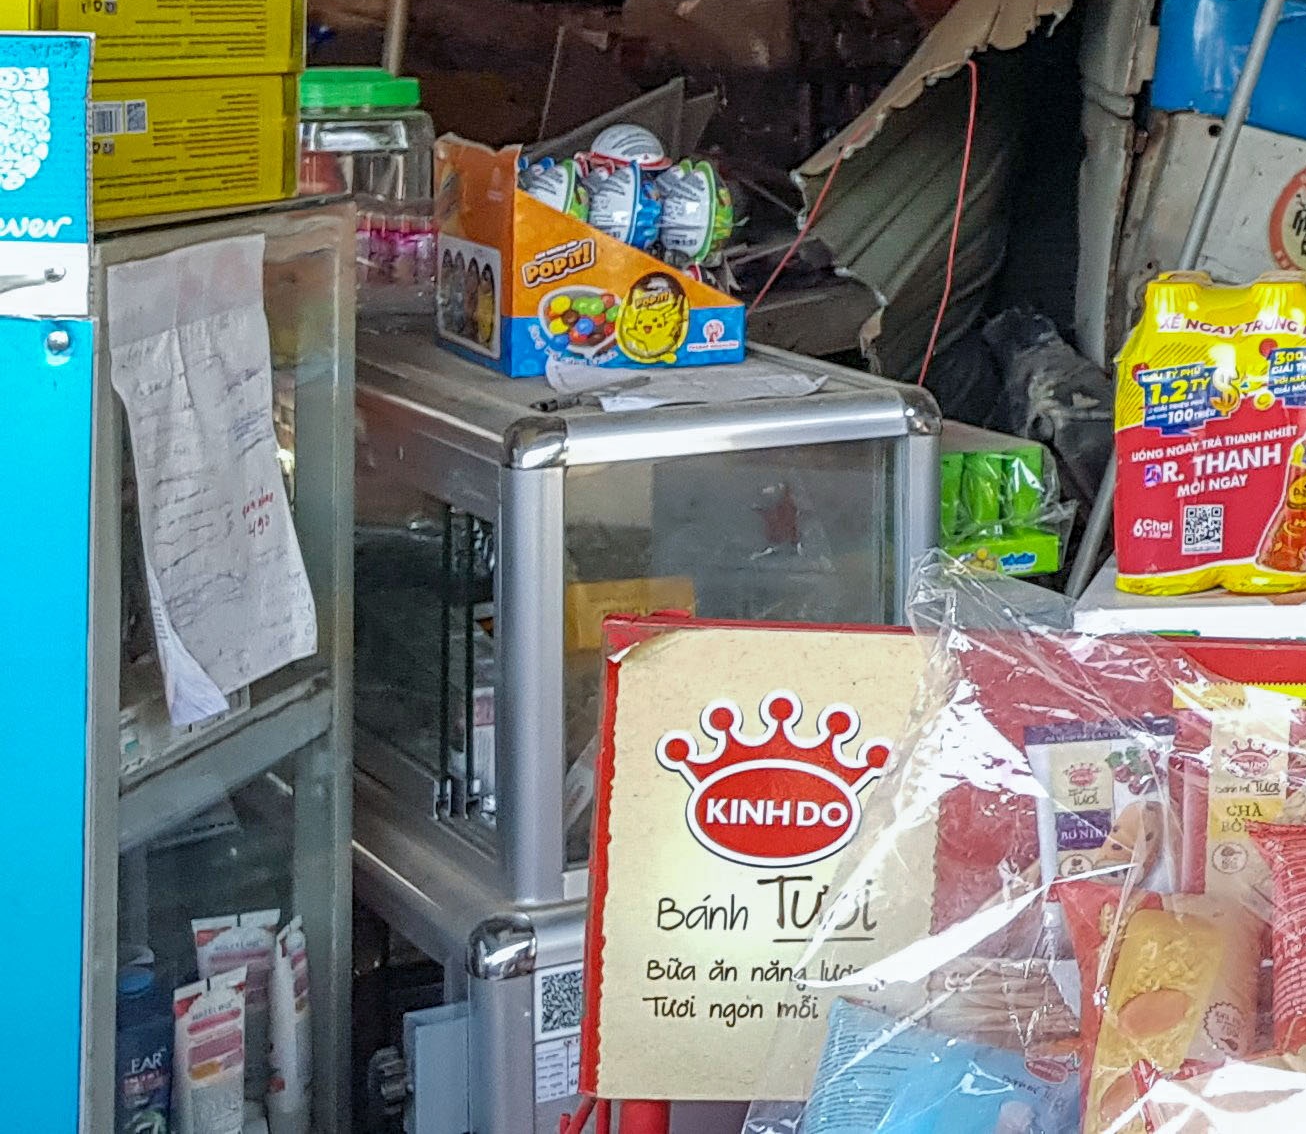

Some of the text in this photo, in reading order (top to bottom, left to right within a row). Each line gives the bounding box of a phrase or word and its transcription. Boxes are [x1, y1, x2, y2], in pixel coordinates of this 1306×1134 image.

[1186, 318, 1240, 336] NGAY
[1149, 380, 1187, 406] 1.2
[1168, 410, 1193, 423] 100
[1165, 443, 1200, 458] NGAY
[1225, 433, 1262, 447] THANH
[1192, 443, 1282, 477] THANH
[1132, 518, 1143, 538] 6
[656, 896, 749, 931] Bánh
[646, 957, 808, 992] Bữa ăn năng
[642, 995, 697, 1018] Tươi
[776, 994, 820, 1019] mỗi
